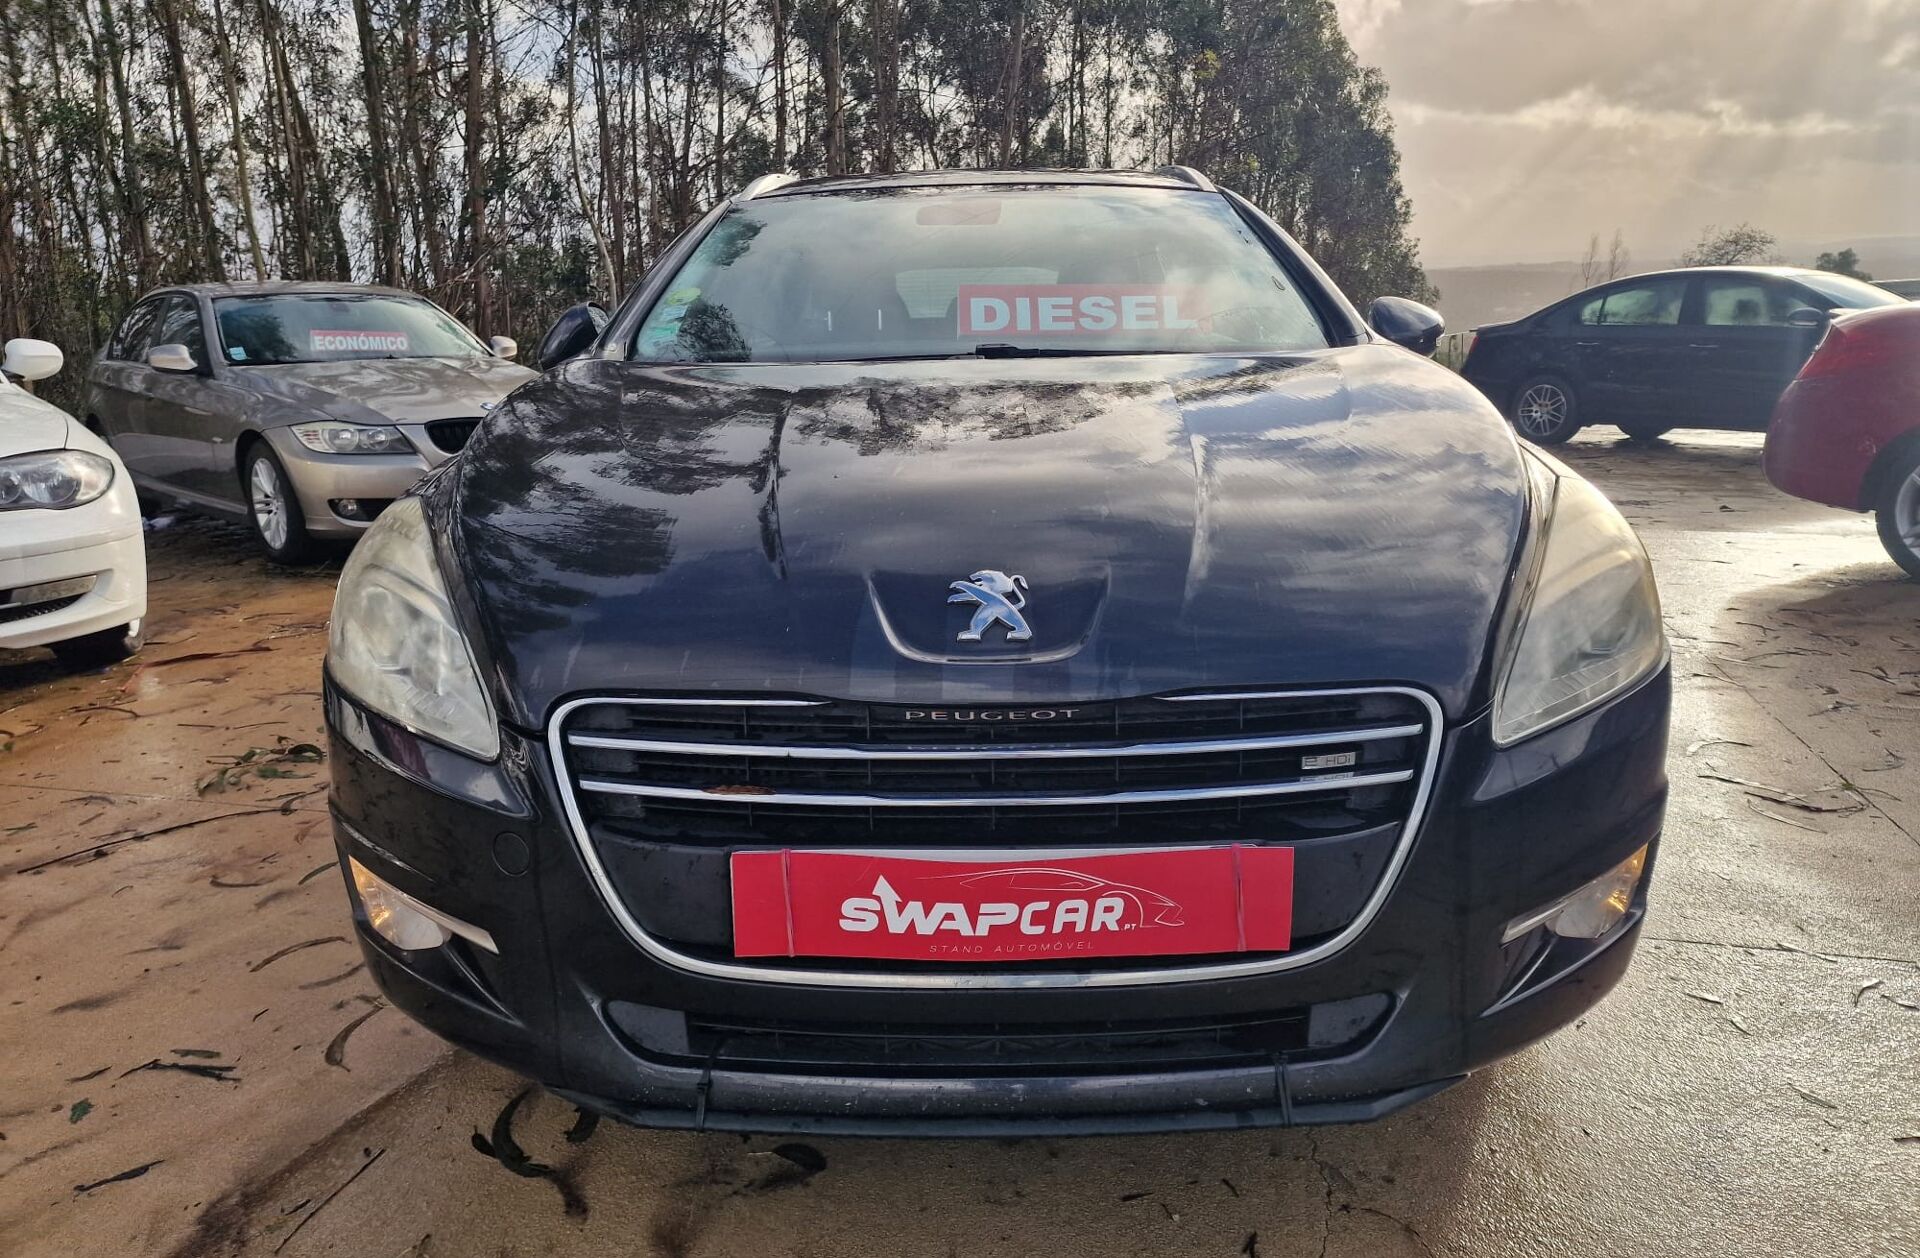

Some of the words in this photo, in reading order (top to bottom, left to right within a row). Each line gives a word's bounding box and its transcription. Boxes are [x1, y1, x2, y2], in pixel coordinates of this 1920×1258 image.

[970, 296, 1198, 331] DIESEL
[315, 332, 408, 351] ECONÓMICO
[904, 709, 1080, 720] PEUGEOT
[929, 945, 983, 954] STAND
[994, 941, 1095, 953] AUTOMÓVEL
